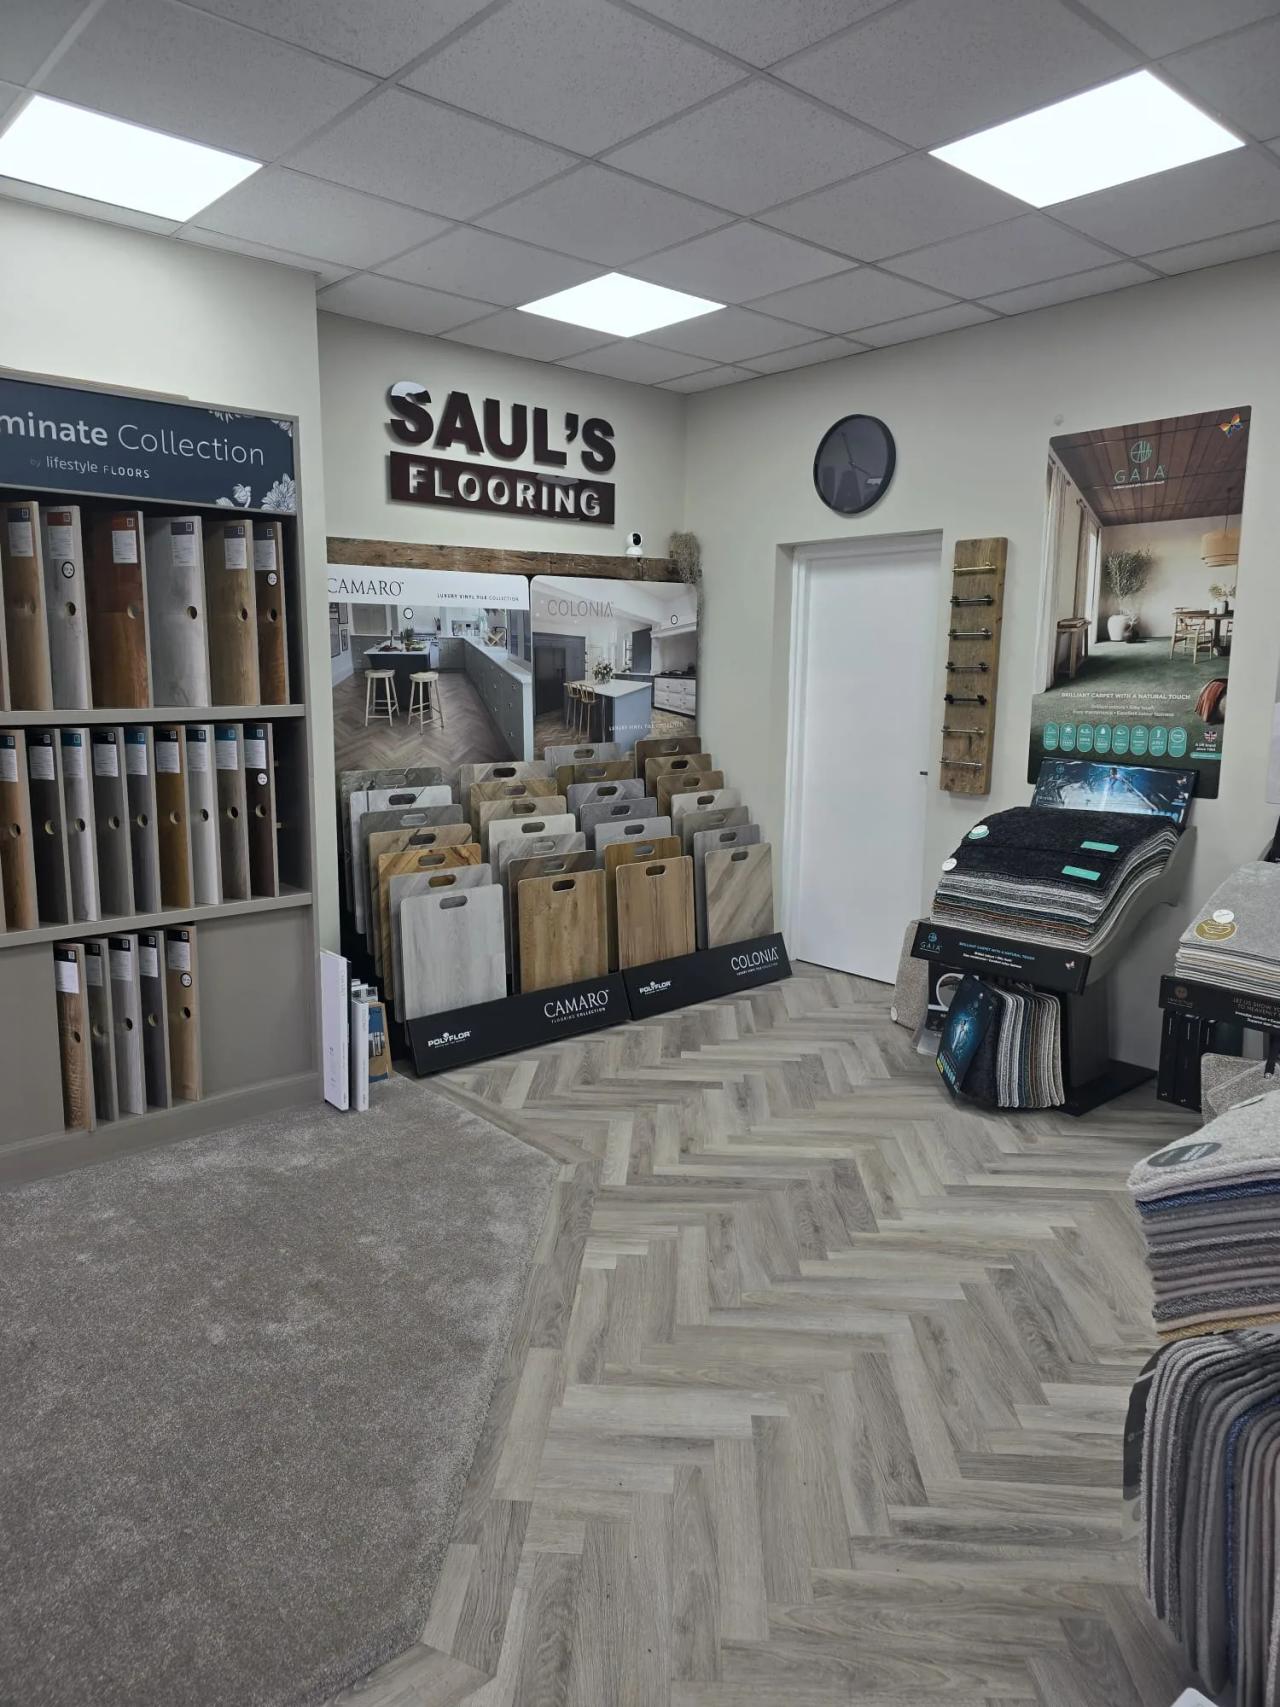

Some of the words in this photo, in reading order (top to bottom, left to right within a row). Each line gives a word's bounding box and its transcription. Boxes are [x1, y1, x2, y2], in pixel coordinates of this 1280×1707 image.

[388, 380, 616, 473] SAUL'S
[118, 424, 264, 466] Collection
[46, 455, 98, 474] lifestyle
[103, 465, 150, 479] FLOORS
[1114, 464, 1167, 484] GAIA
[408, 462, 601, 517] FLOORING
[328, 577, 402, 597] CAMARO
[547, 599, 615, 618] COLONIA
[920, 941, 940, 951] GAIA
[731, 947, 779, 970] COLONIA
[639, 981, 671, 994] POLYFLOR
[544, 990, 609, 1018] CAMARO
[428, 1031, 471, 1047] POLYFLOR
